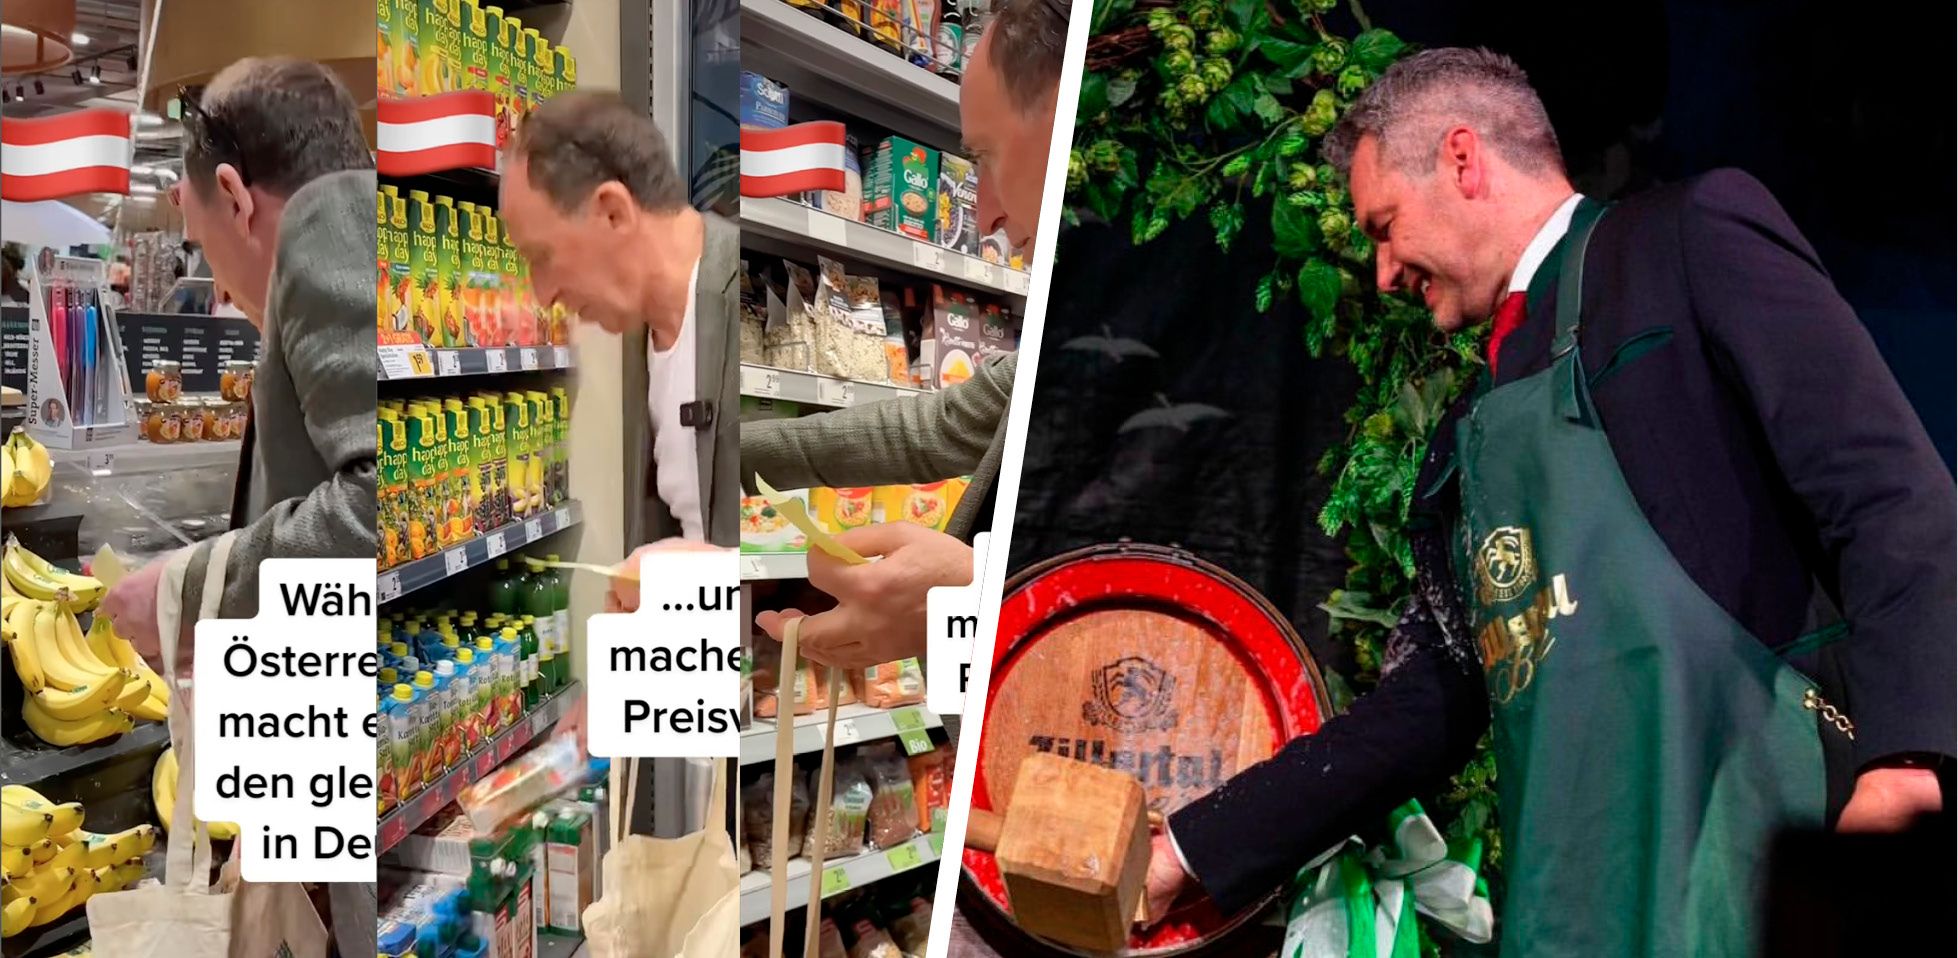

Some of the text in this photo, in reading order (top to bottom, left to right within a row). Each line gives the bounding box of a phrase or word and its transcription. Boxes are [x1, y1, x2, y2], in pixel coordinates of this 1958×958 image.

[904, 169, 929, 189] Gallo
[947, 312, 969, 330] Gallo
[908, 738, 929, 753] Bio
